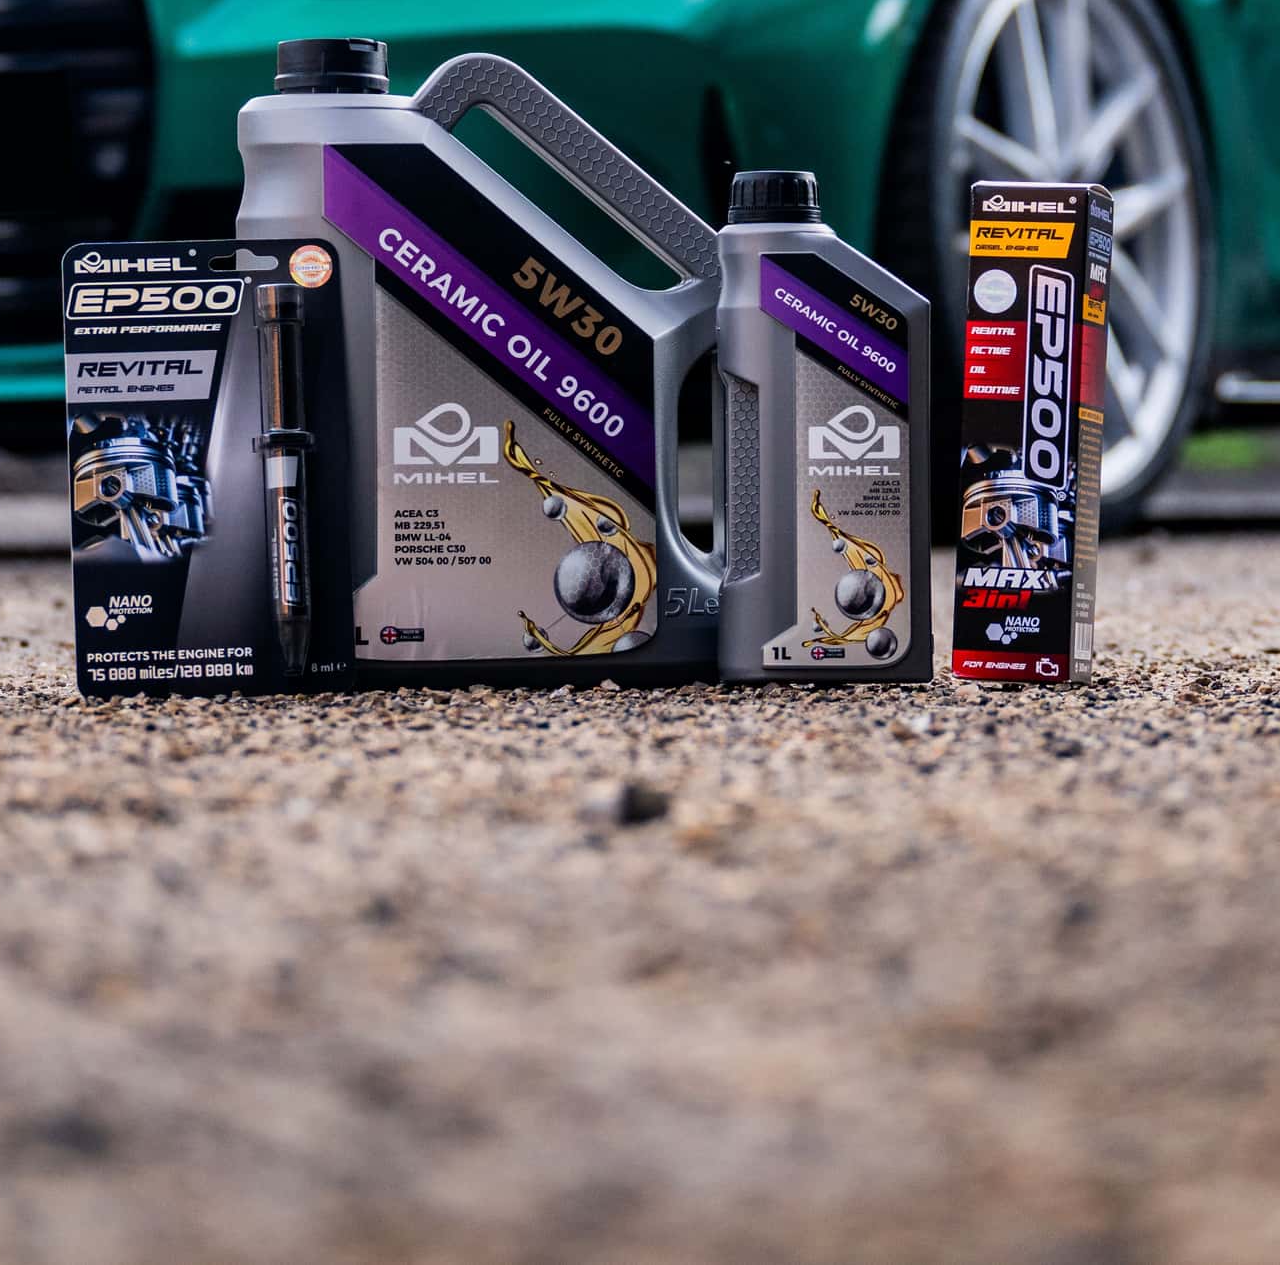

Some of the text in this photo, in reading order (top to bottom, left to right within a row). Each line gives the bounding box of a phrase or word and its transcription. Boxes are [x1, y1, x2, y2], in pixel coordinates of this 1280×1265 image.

[982, 194, 1076, 214] MIHEL
[976, 227, 1064, 240] REVITAL
[74, 252, 197, 274] MIHEL
[73, 285, 237, 314] EP500
[512, 256, 623, 356] 5W30
[849, 293, 898, 331] 5W30
[74, 323, 222, 335] EXTRA PERFORMANCE
[378, 228, 625, 437] CERAMIC OIL 9600
[774, 288, 897, 373] CERAMIC OIL 9600
[971, 326, 1016, 336] REVITAL
[970, 346, 1012, 355] ACTIVE
[77, 359, 203, 378] REVITAL
[969, 365, 986, 374] OIL
[1029, 274, 1067, 480] EP500
[77, 384, 175, 395] PETROL ENGINES
[837, 365, 899, 410] FULLY SYNTHETIC
[968, 385, 1020, 395] ADDITIVE
[543, 408, 625, 478] FULLY SYNTHETIC
[808, 466, 901, 476] MIHEL
[393, 472, 500, 484] MIHEL
[394, 509, 439, 518] ACEA C3
[394, 522, 411, 530] MB
[394, 533, 451, 542] BMW LL-04
[394, 545, 466, 554] PORSCHE C30
[394, 556, 492, 566] VW 504 00 / 507 00
[964, 567, 1046, 590] MAX
[108, 594, 153, 608] NANO
[962, 589, 1034, 609] 3in1
[108, 607, 153, 615] PROTECTION
[1004, 616, 1040, 627] NANO
[356, 626, 369, 646] L
[87, 647, 253, 663] PROTECTS THE ENGINE FOR
[772, 646, 791, 660] 1L
[311, 663, 318, 672] 8
[320, 662, 334, 672] ml
[962, 660, 1027, 670] FOR ENGINES
[87, 668, 106, 682] 75
[236, 662, 254, 676] km
